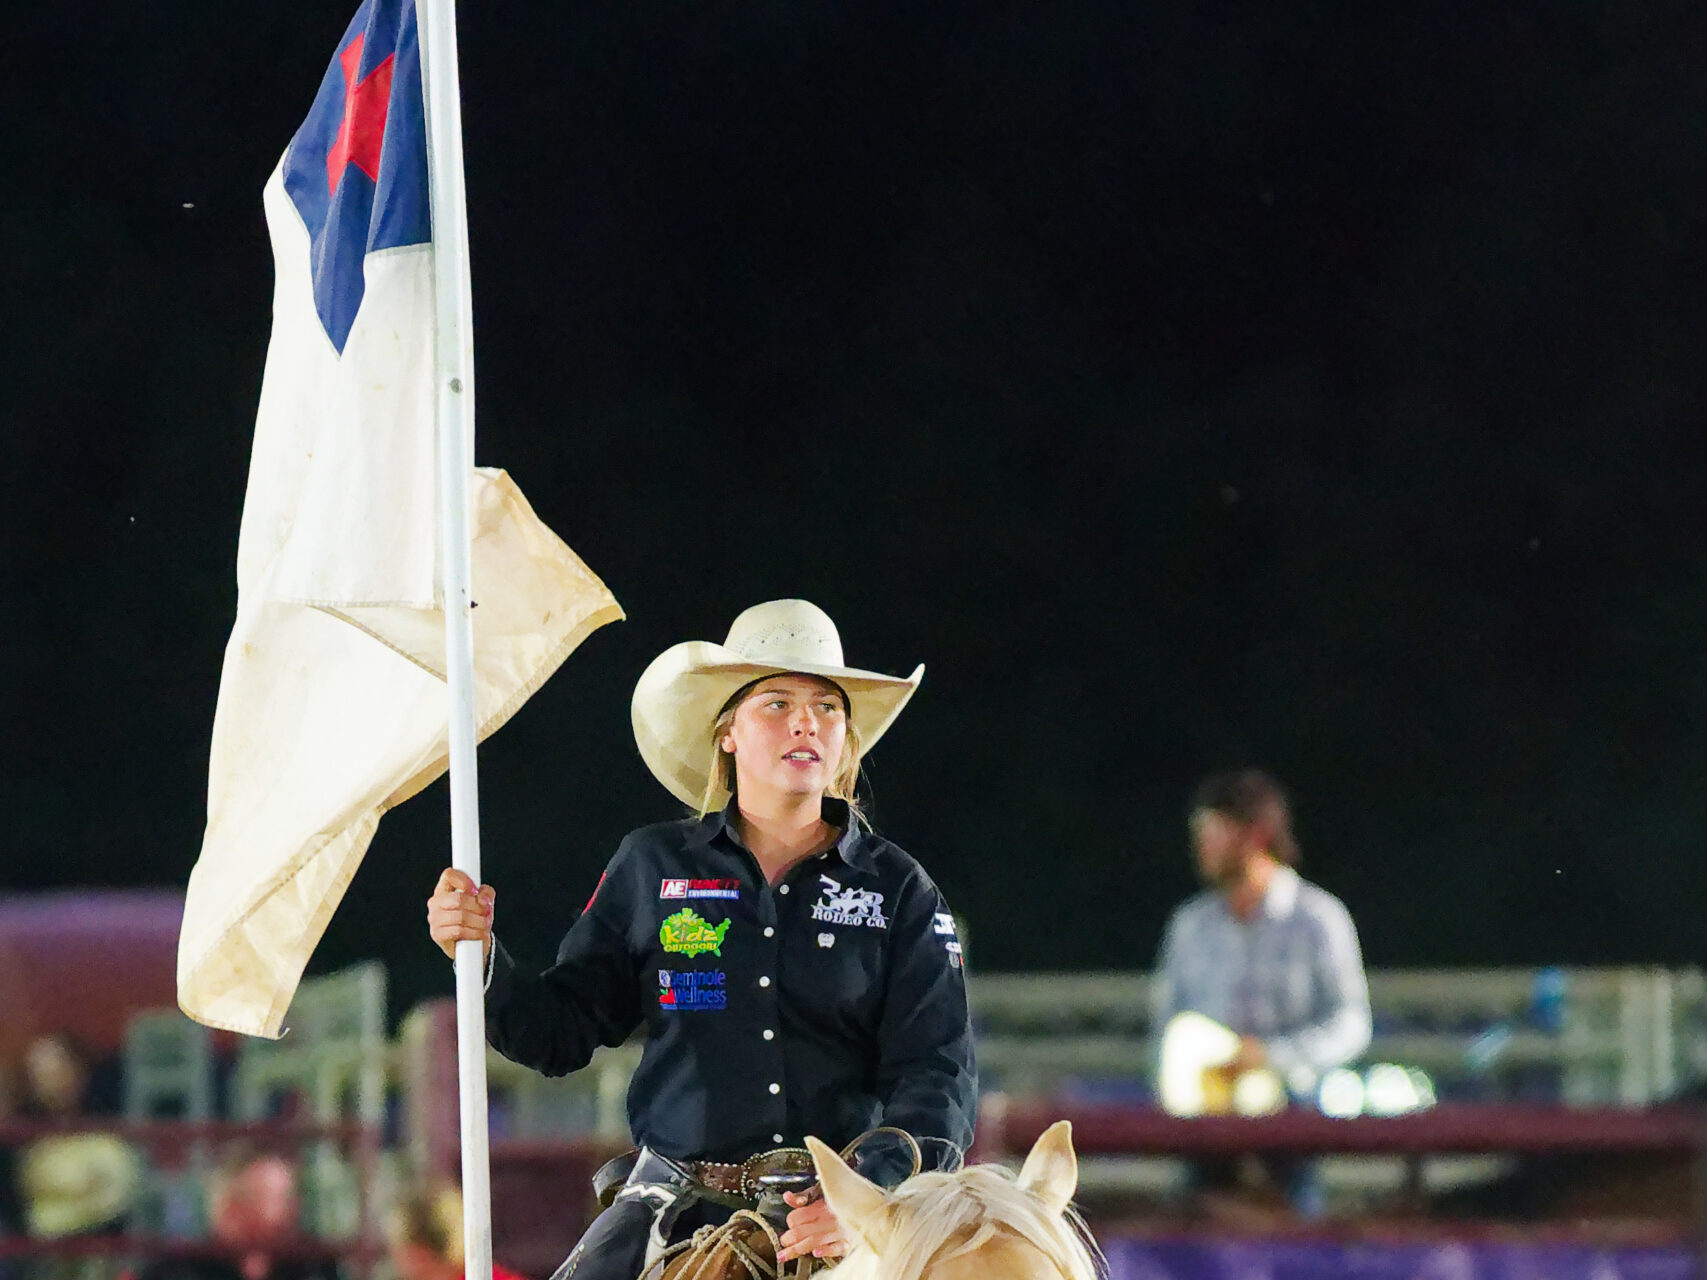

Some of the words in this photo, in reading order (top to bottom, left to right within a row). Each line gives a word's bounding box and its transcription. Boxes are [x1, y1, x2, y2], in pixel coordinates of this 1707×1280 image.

[663, 881, 685, 896] AE
[811, 907, 863, 927] RODEO
[674, 986, 727, 1004] Wellness
